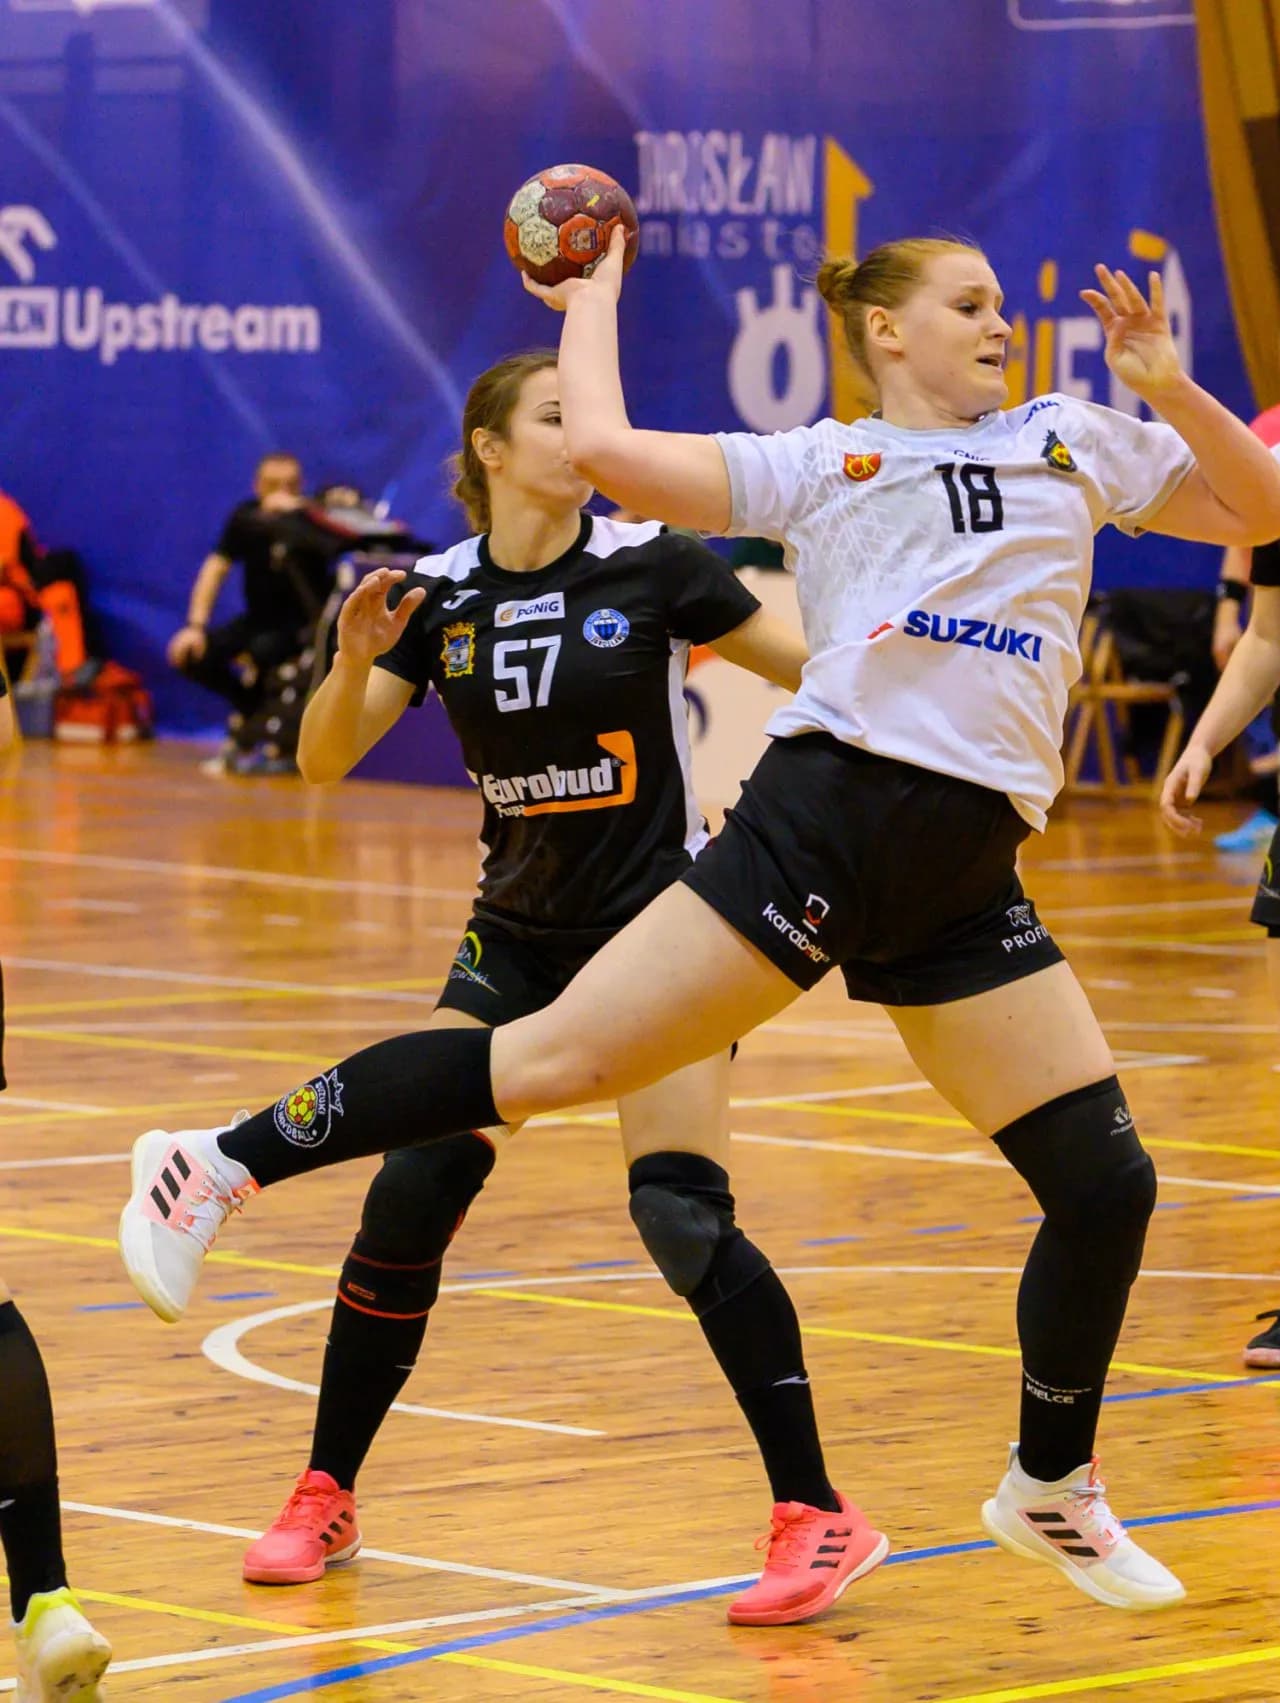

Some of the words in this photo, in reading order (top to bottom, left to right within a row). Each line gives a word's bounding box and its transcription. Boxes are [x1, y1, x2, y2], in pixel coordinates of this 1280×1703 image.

[62, 286, 321, 366] Upstream
[934, 462, 1003, 533] 18
[904, 610, 1042, 662] SUZUKI
[493, 635, 562, 713] 57
[483, 758, 613, 804] Eurobud
[1026, 1381, 1075, 1404] KIELCE
